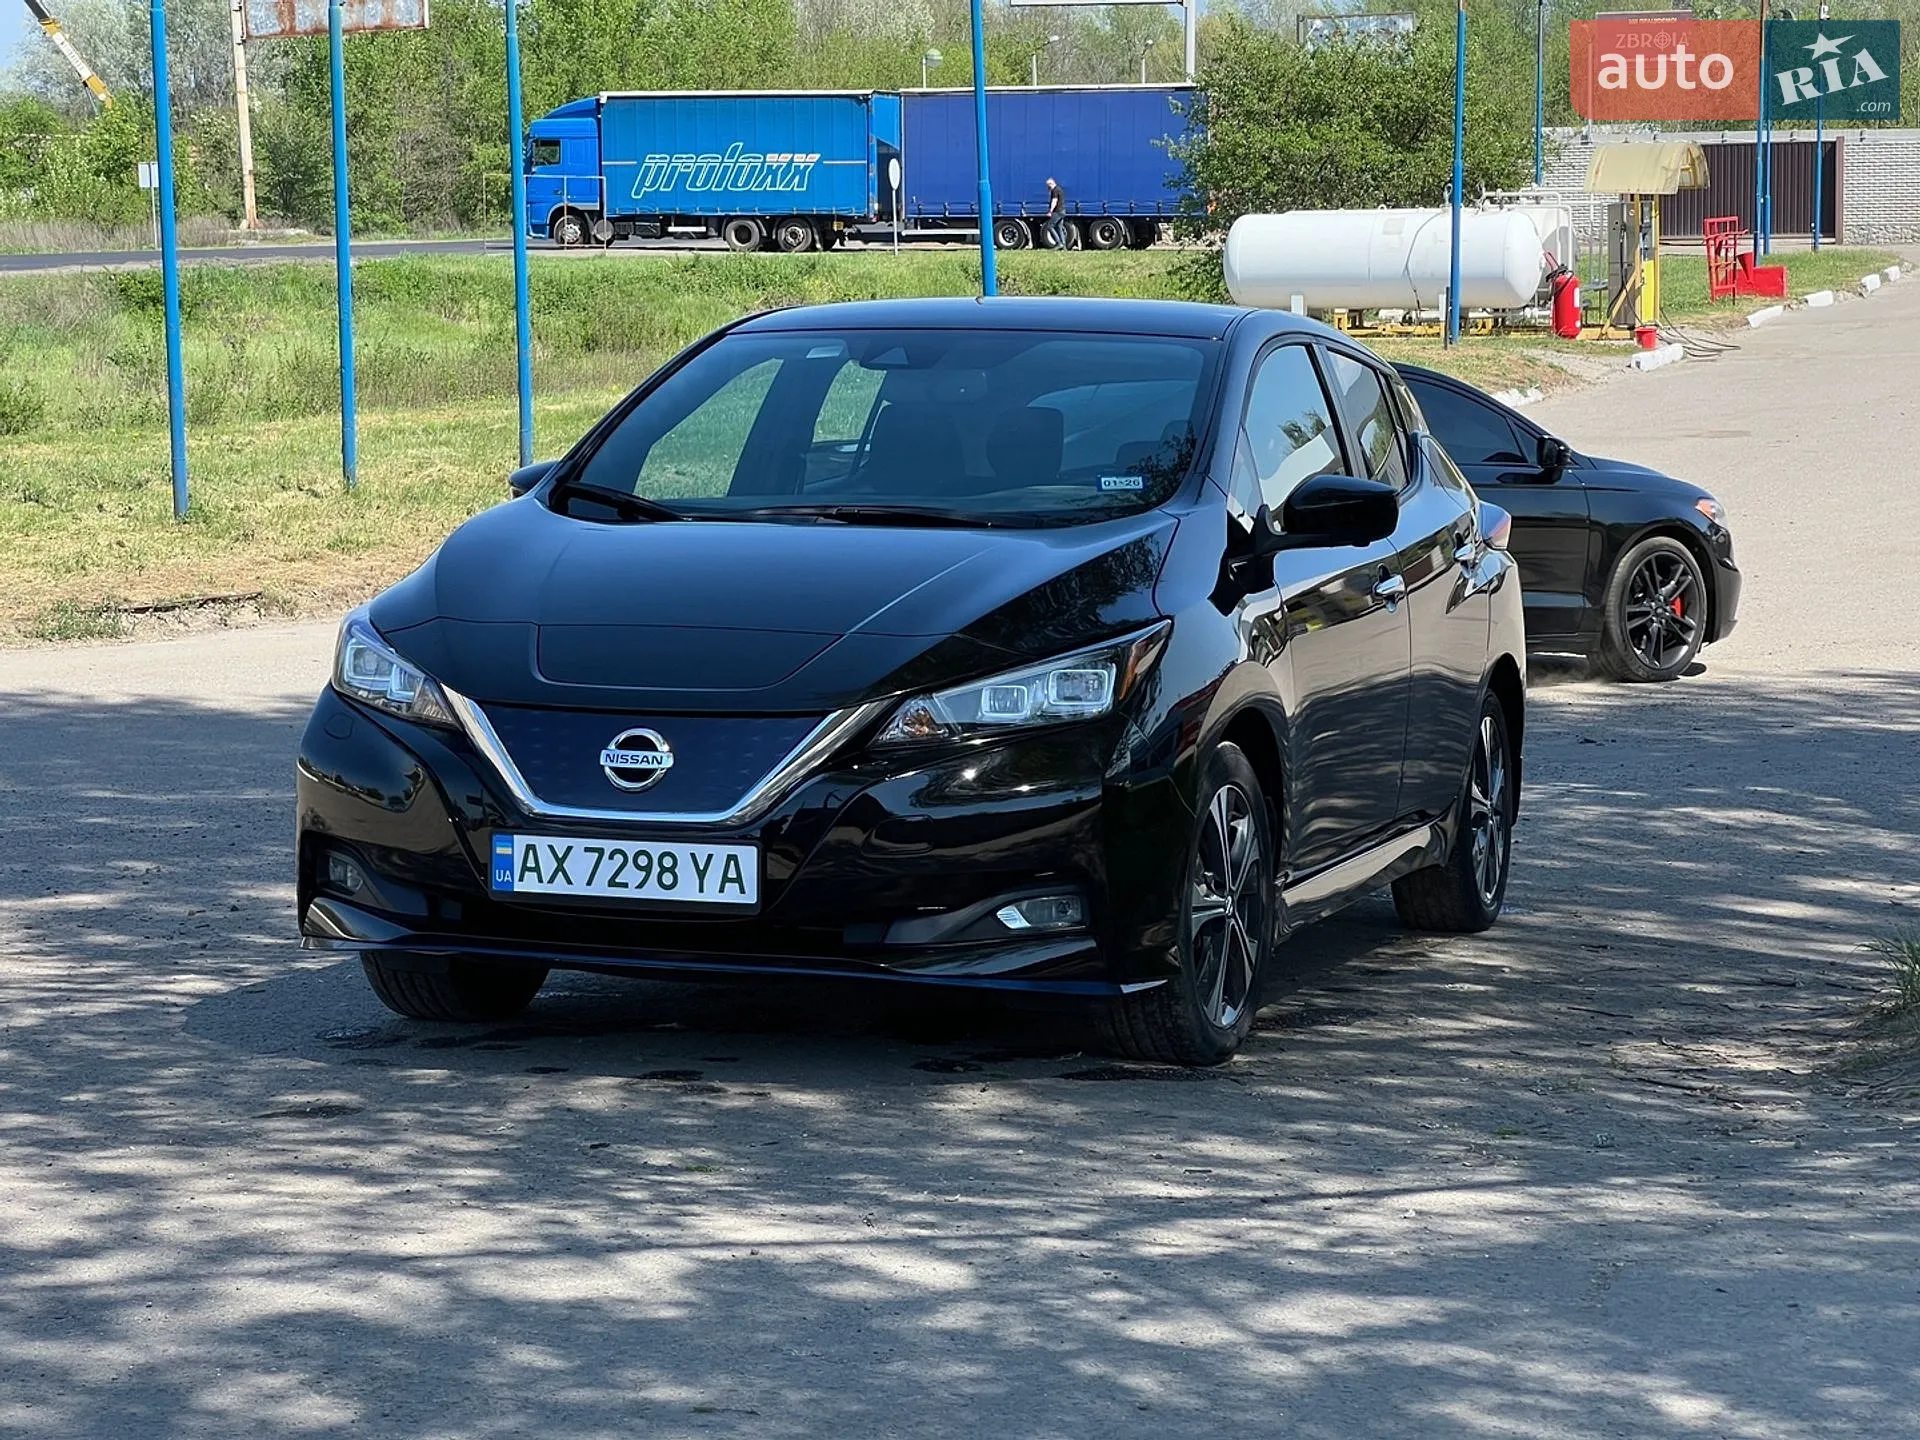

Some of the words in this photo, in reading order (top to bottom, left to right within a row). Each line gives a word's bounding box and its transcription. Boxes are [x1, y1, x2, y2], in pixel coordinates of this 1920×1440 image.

[605, 753, 663, 765] NISSAN
[518, 843, 573, 886] AX
[583, 846, 678, 891] 7298
[689, 852, 747, 895] YA
[495, 870, 512, 883] UA
